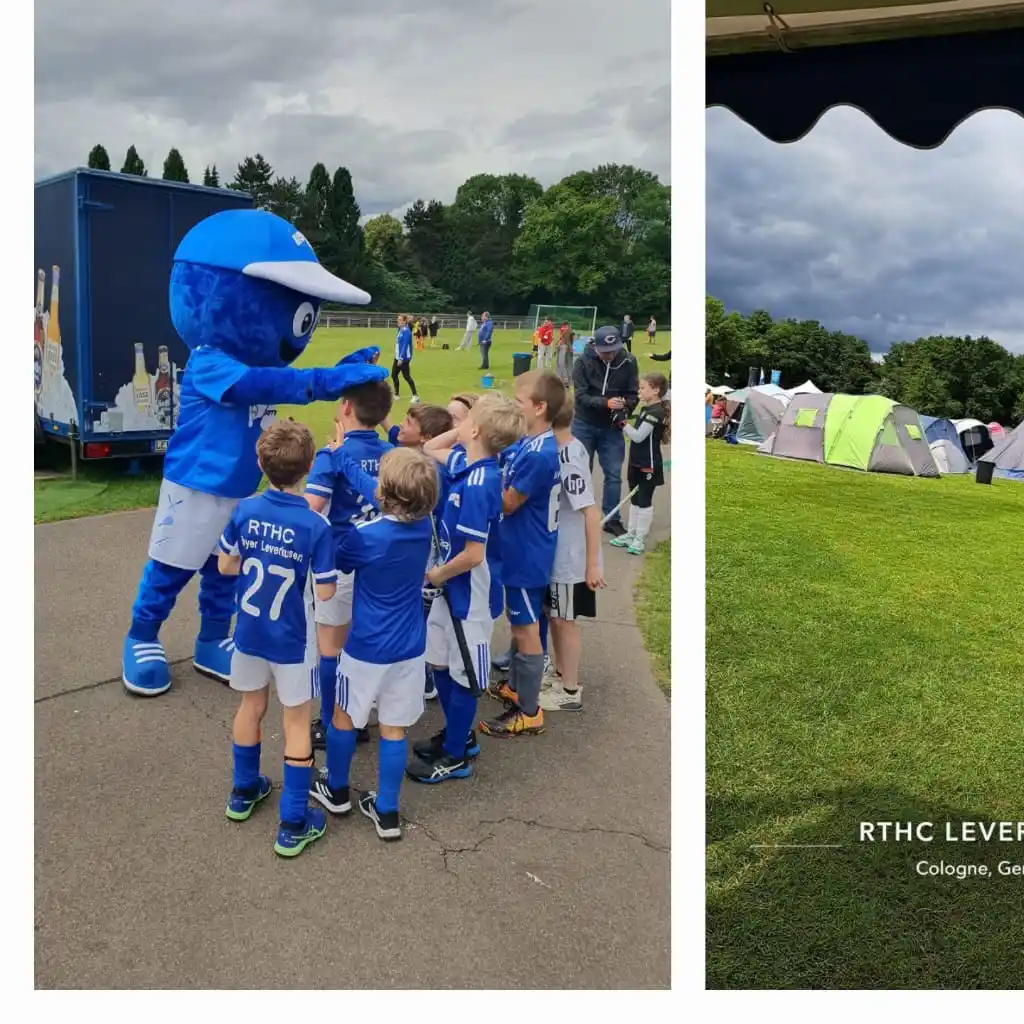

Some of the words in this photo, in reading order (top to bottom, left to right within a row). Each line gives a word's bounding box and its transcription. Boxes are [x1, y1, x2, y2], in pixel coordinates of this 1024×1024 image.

[361, 459, 380, 473] RTH
[247, 519, 296, 544] RTHC
[241, 557, 296, 622] 27
